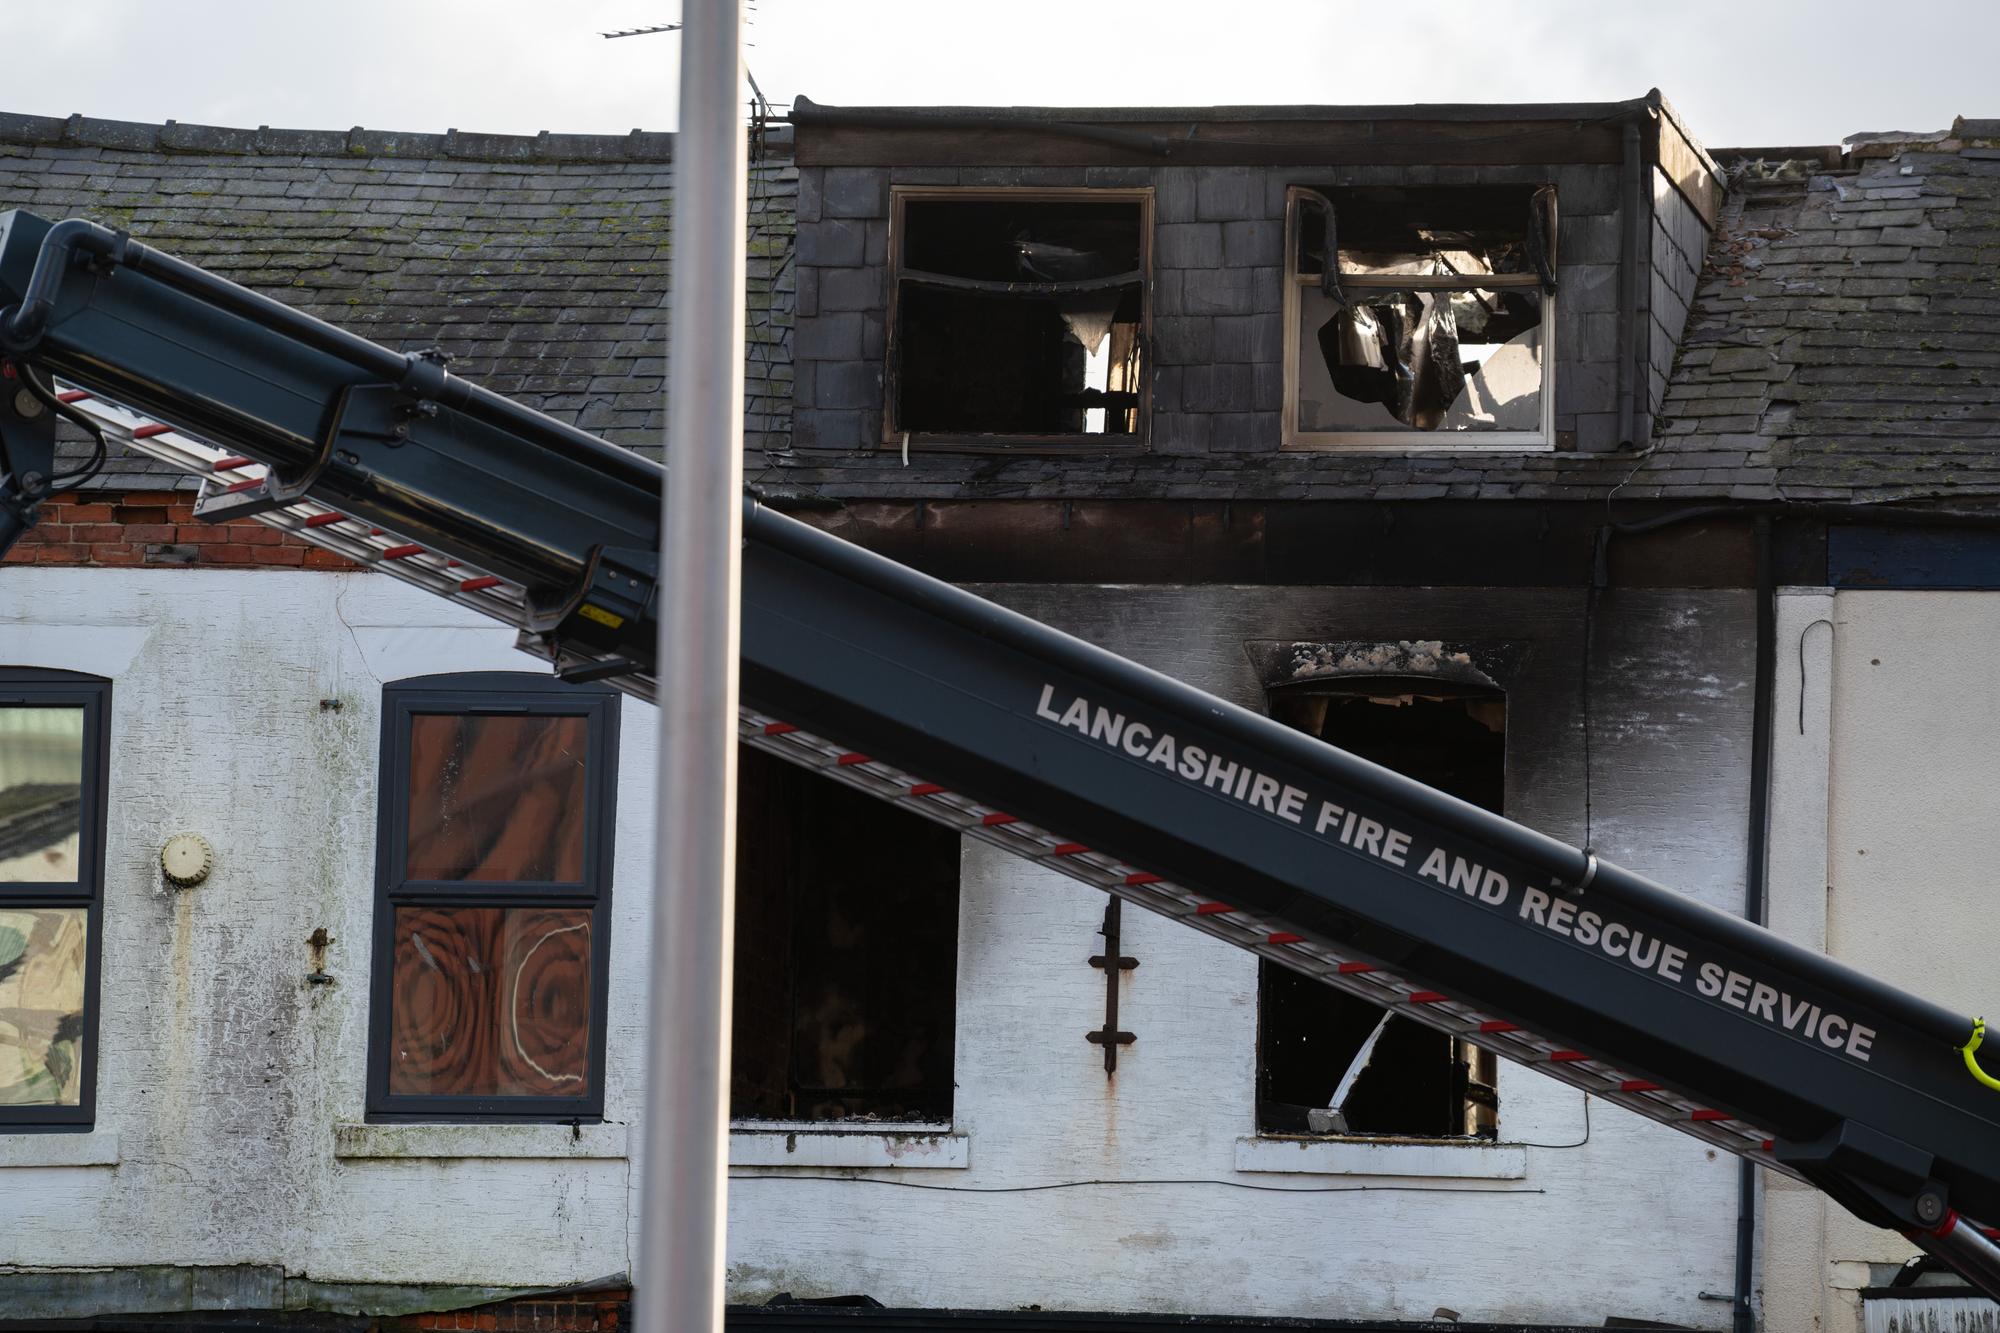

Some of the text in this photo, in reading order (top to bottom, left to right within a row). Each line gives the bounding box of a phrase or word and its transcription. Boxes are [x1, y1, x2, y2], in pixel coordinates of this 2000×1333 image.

[1036, 684, 1876, 1062] LANCASHIRE FIRE AND RESCUE SERVICE
